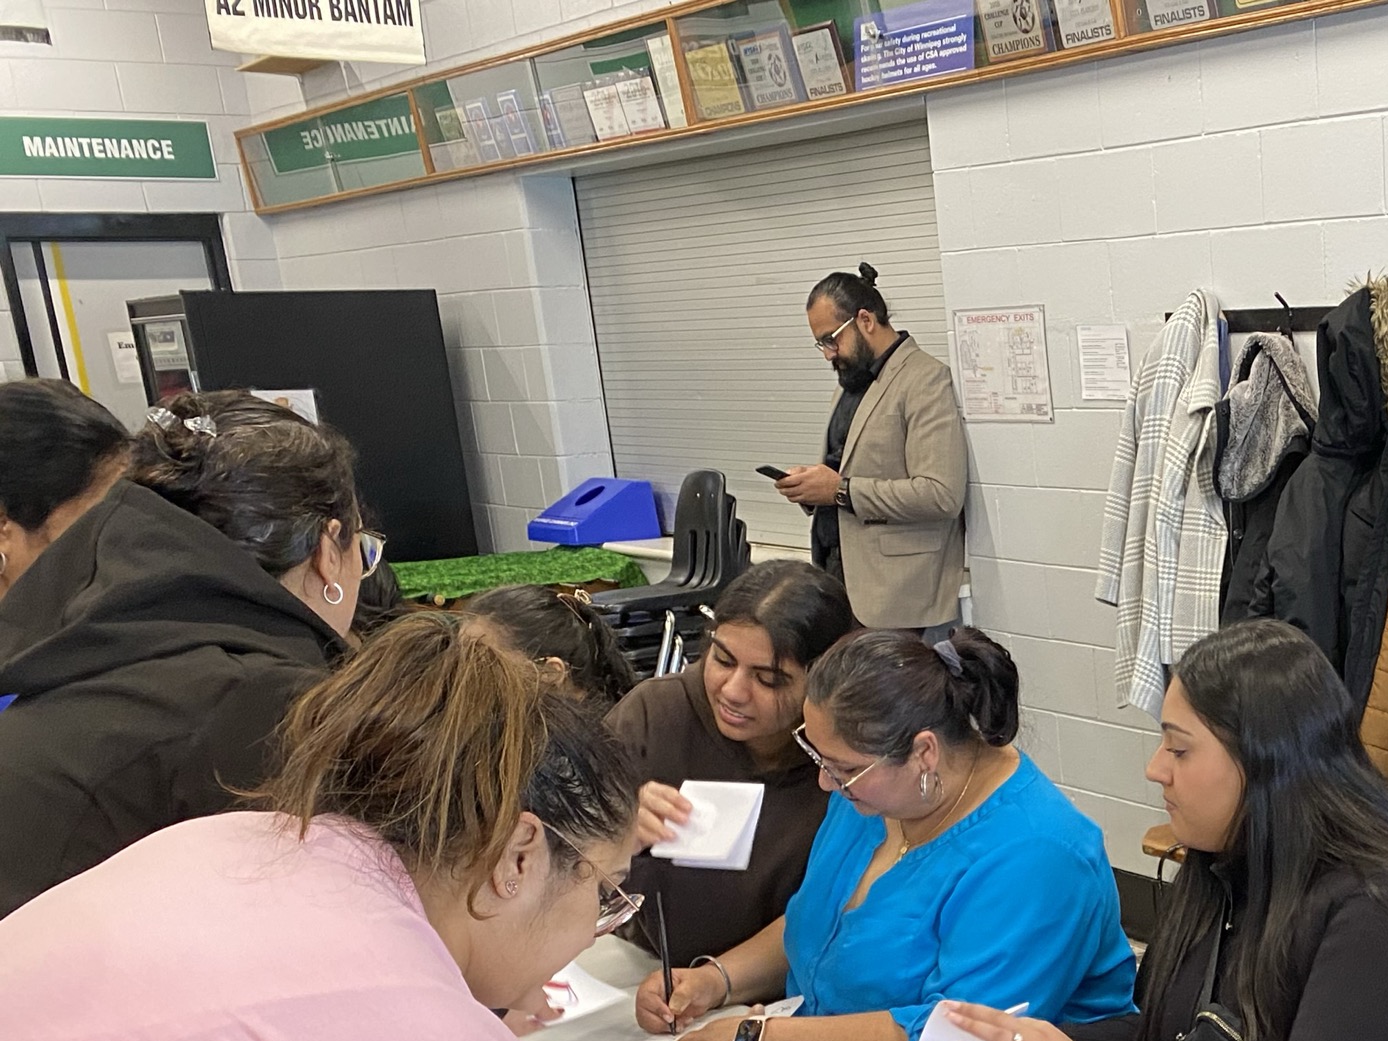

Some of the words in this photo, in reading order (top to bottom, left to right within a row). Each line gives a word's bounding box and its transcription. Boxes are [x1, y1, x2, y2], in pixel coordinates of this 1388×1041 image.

[253, 0, 323, 21] MINOR
[329, 0, 414, 27] BANTAM
[1153, 5, 1206, 26] FINALISTS
[861, 44, 870, 53] For
[902, 33, 921, 44] during
[921, 24, 957, 39] recreational
[991, 35, 1041, 55] CHAMPIONS
[1065, 24, 1112, 45] FINALISTS
[883, 48, 894, 58] The
[895, 46, 906, 57] City
[907, 44, 914, 53] of
[914, 39, 942, 52] Winnipeg
[942, 33, 967, 46] strongly
[896, 57, 906, 66] the
[906, 54, 917, 63] use
[918, 52, 925, 61] of
[925, 49, 938, 59] CSA
[939, 44, 967, 58] approved
[881, 69, 903, 80] helmets
[904, 66, 913, 75] for
[921, 62, 937, 73] ages.
[809, 82, 844, 97] FINALISTS
[22, 135, 175, 161] MAINTENANCE
[966, 313, 1011, 324] EMERGENCY
[1013, 313, 1035, 322] EXITS
